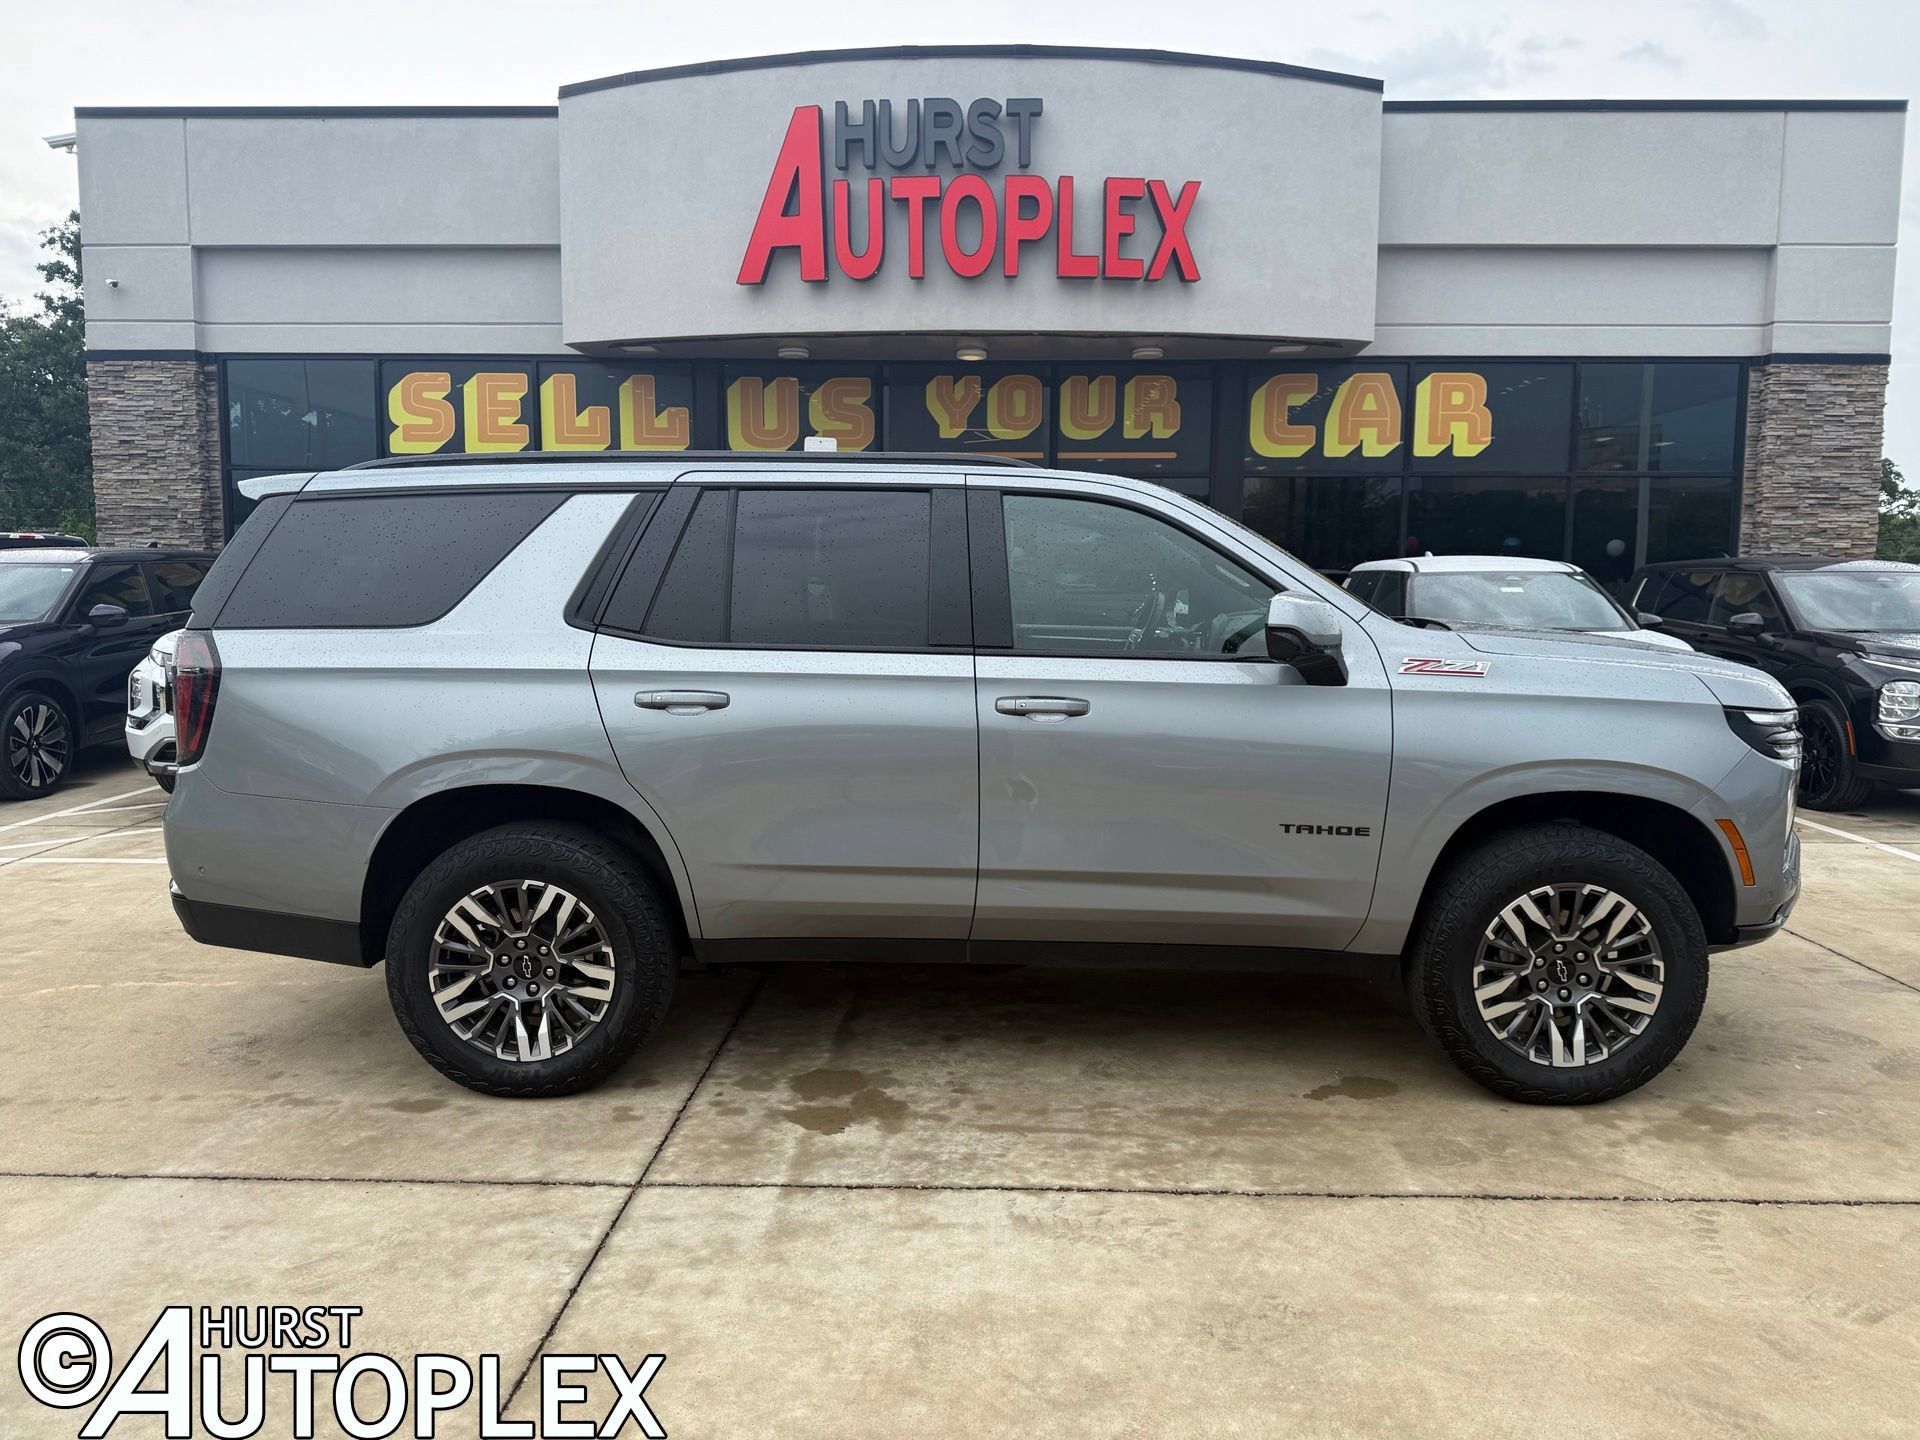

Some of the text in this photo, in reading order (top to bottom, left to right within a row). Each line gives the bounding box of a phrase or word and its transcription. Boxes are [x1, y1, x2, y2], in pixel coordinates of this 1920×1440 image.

[835, 97, 1043, 169] HURST
[736, 104, 1202, 285] AUTOPLEX
[388, 371, 1493, 458] SELL US YOUR CAR
[1398, 657, 1492, 677] Z71
[1279, 823, 1371, 837] TAHOE
